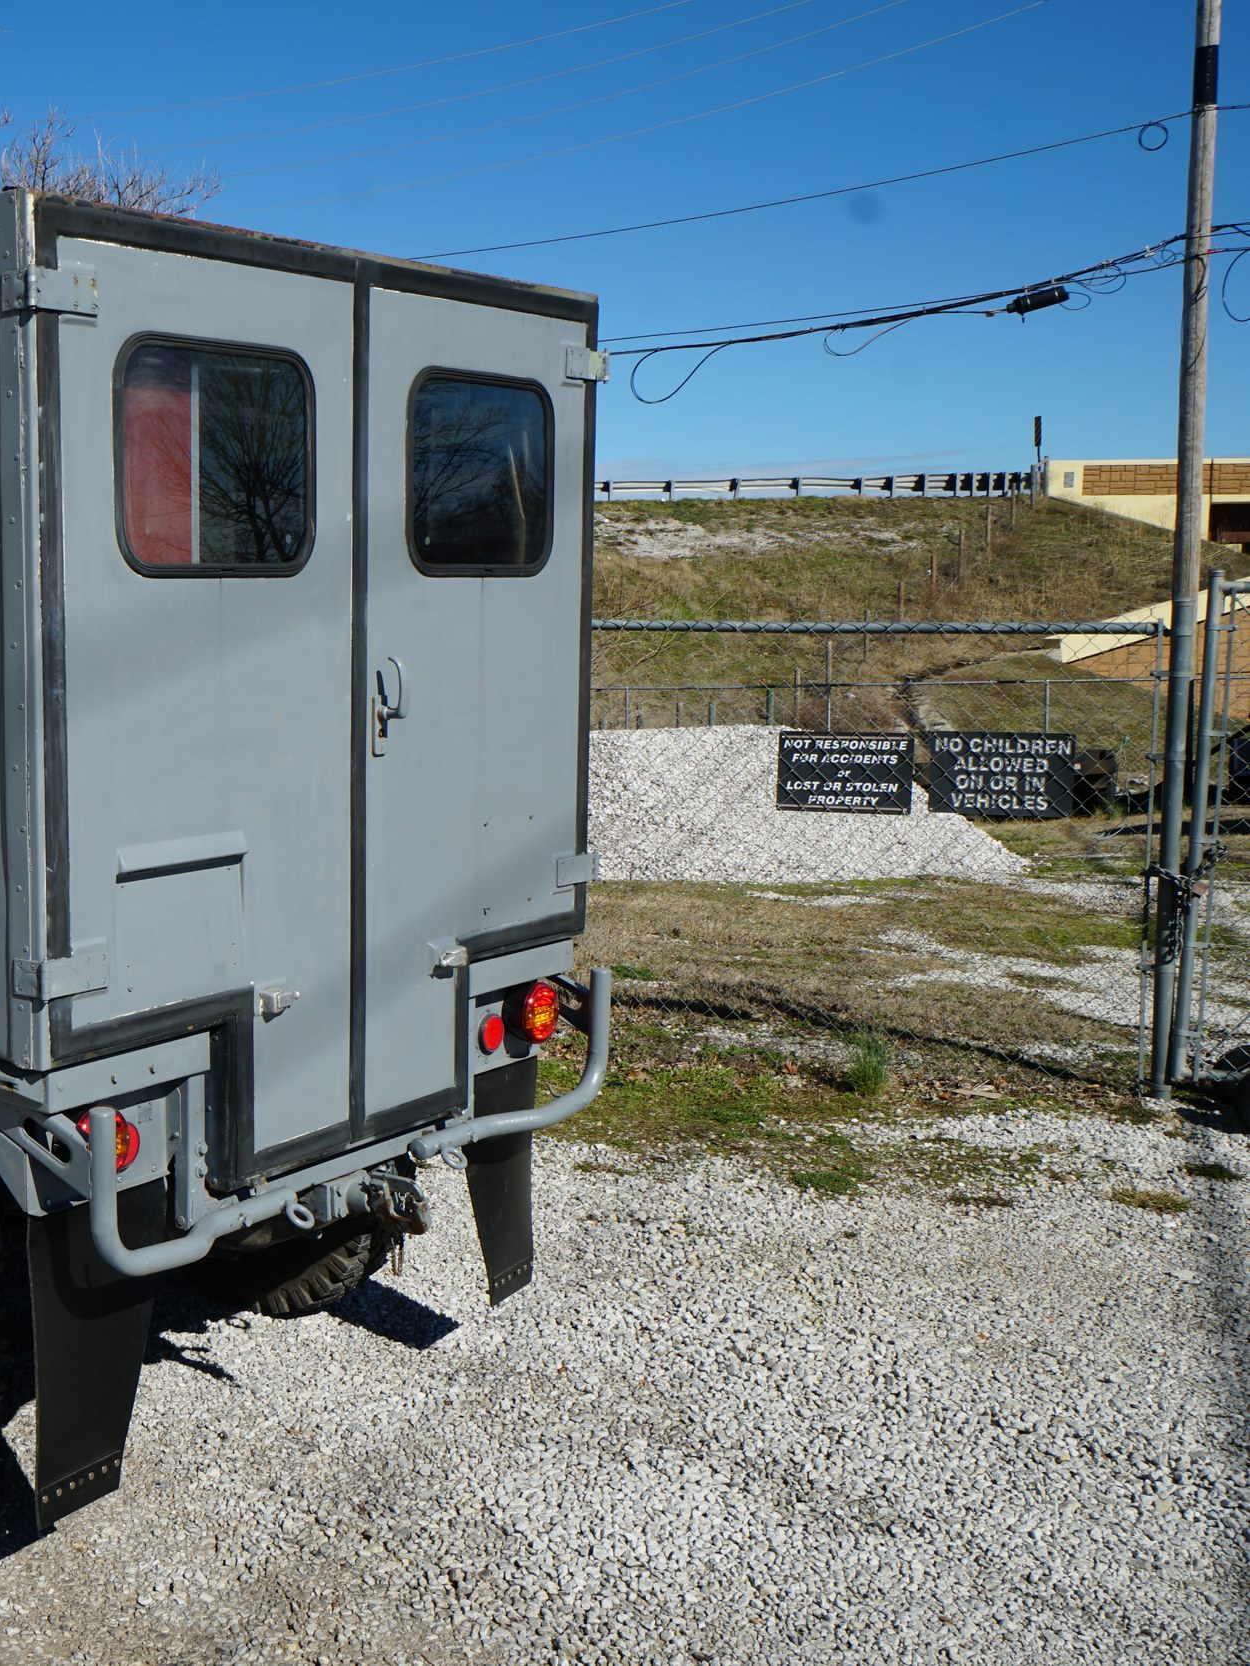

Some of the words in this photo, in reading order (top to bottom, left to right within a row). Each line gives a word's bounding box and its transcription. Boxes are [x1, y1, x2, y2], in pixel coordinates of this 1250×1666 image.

[783, 739, 811, 749] NOT
[815, 740, 908, 751] RESPONSIBLE
[934, 737, 963, 753] NO
[969, 738, 1072, 756] CHILDREN
[791, 753, 818, 763] FOR
[821, 753, 899, 765] ACCIDENTS
[954, 756, 1050, 773] ALLOWED
[785, 780, 820, 791] LOST
[823, 781, 842, 791] OR
[845, 782, 898, 793] STOLEN
[956, 774, 985, 790] ON
[990, 776, 1018, 791] OR
[1025, 777, 1046, 792] IN
[807, 794, 880, 806] PROPERTY
[951, 792, 1050, 811] VEHICLES
